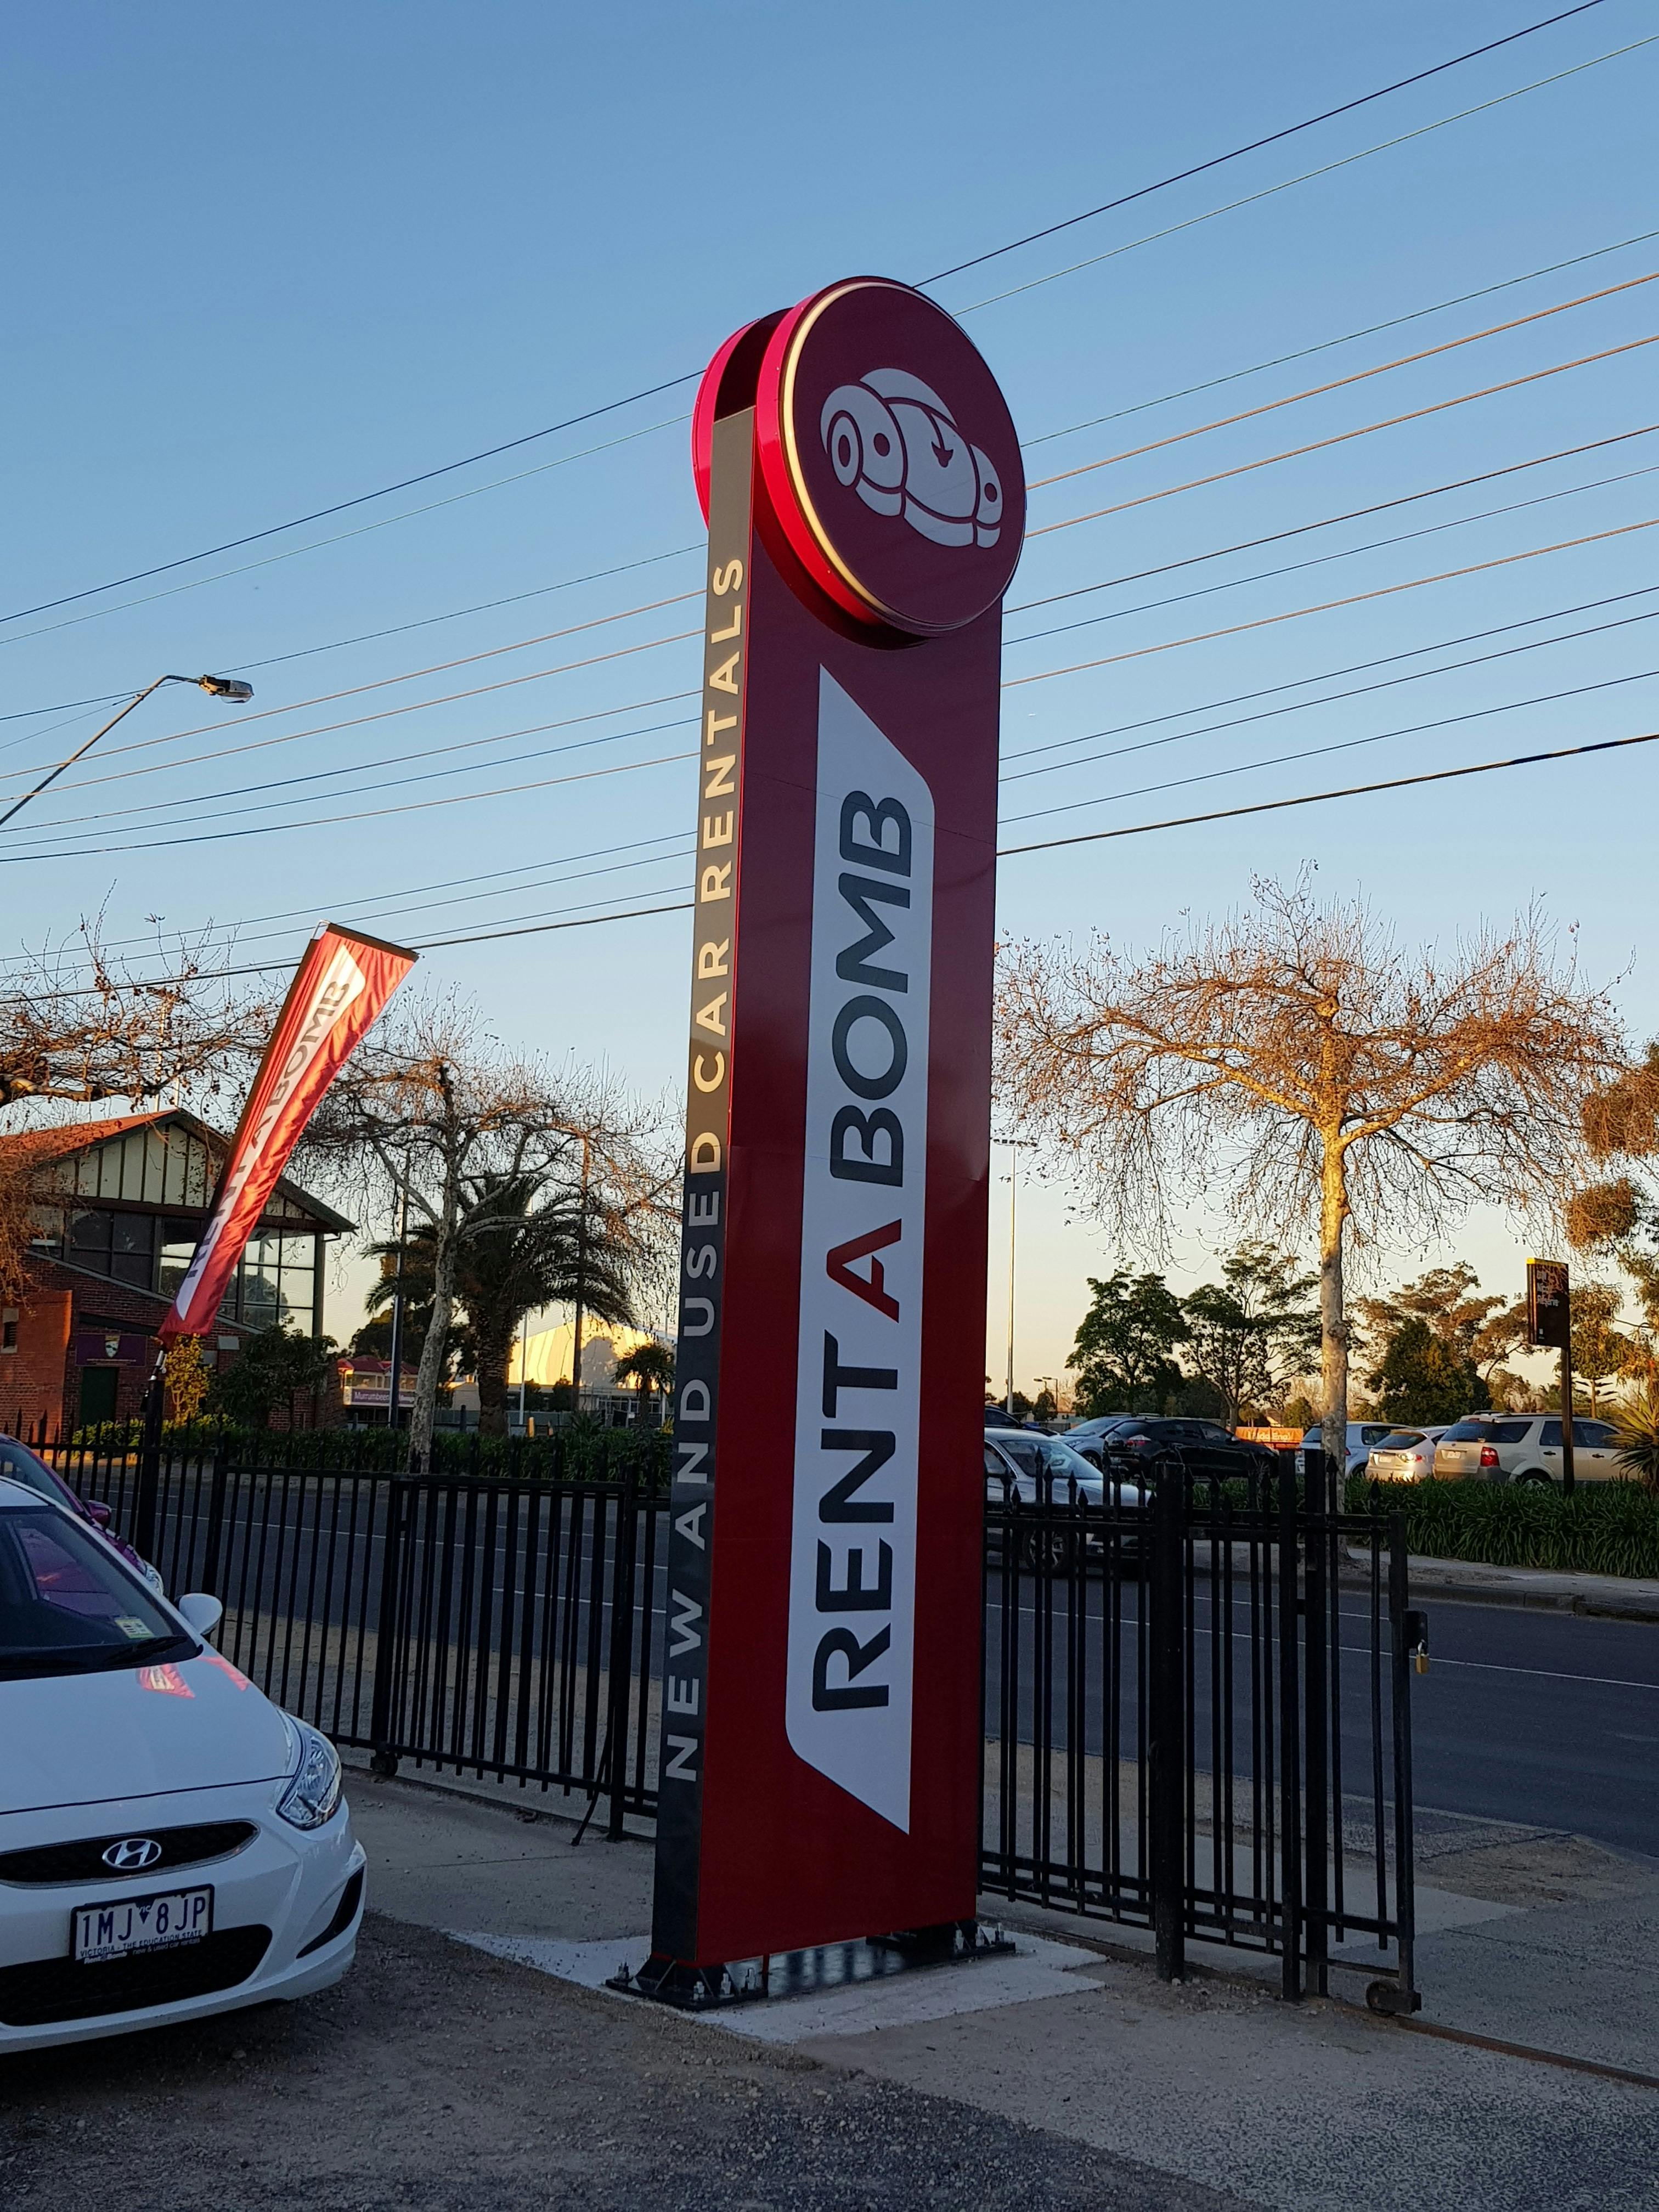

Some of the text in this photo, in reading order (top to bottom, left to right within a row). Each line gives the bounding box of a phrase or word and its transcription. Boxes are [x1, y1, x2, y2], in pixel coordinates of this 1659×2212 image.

[665, 558, 744, 1782] NEW AND USED CAR RENTALS
[80, 1945, 115, 1957] VICTORIA
[123, 1942, 137, 1950] THE
[139, 1933, 180, 1948] EDUCATION
[182, 1929, 202, 1939] STATE
[83, 1896, 206, 1948] 1MJ 8JP
